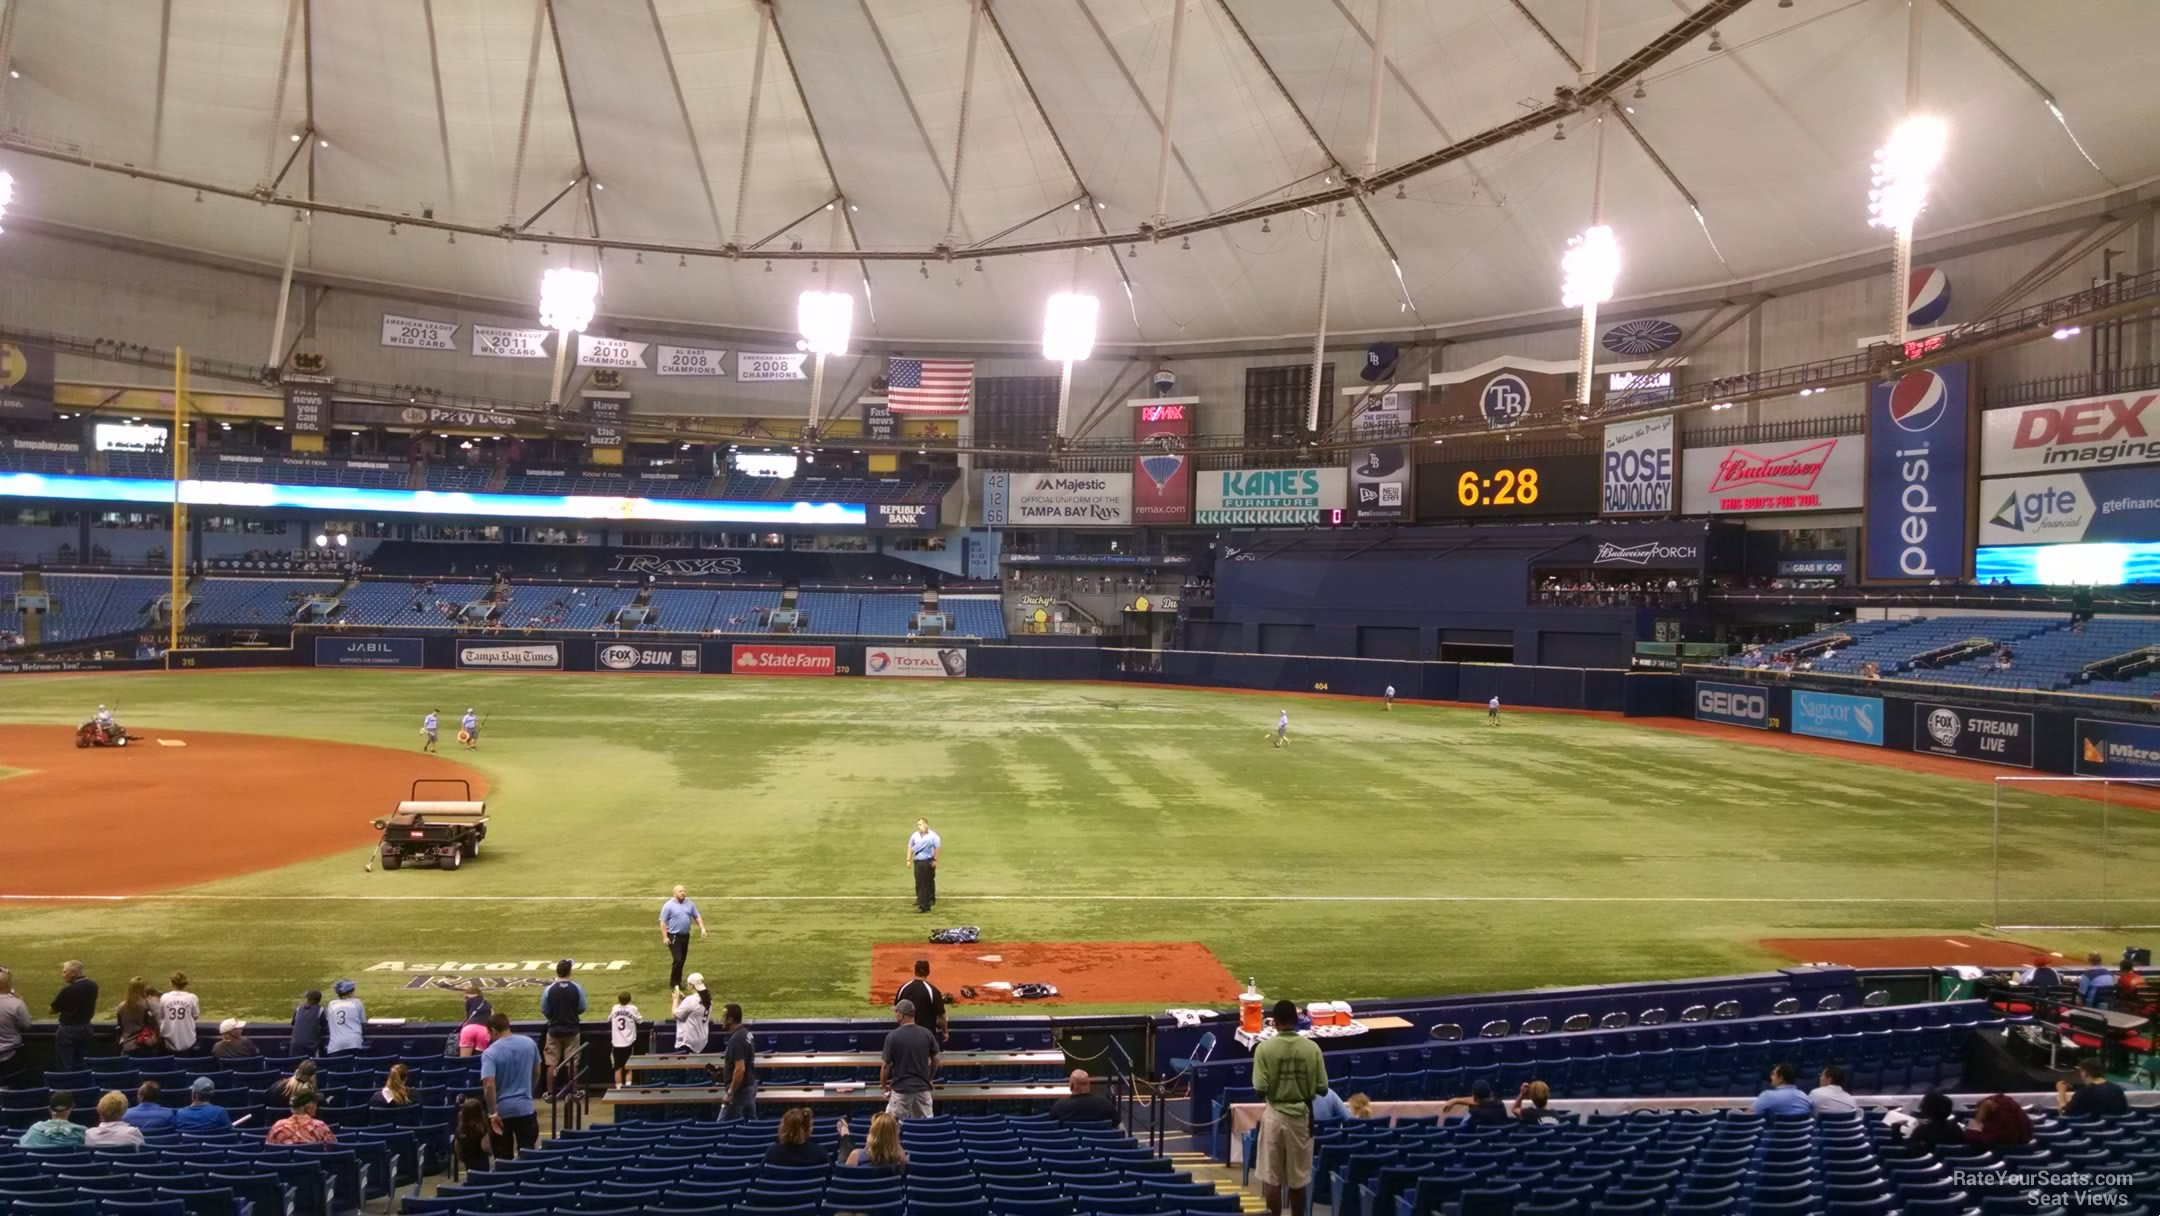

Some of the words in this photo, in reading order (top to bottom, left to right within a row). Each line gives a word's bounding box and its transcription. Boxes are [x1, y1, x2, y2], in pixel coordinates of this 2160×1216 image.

[386, 319, 422, 328] AMERICAN
[424, 323, 452, 332] LEAGUE
[401, 326, 438, 340] 2013
[390, 336, 414, 346] WILD
[416, 338, 446, 348] CARD
[492, 336, 527, 348] 2011
[609, 340, 628, 348] EAST
[480, 346, 505, 354] WILD
[509, 348, 536, 356] CARD
[593, 346, 629, 358] 2010
[582, 356, 638, 366] CHAMPIONS
[672, 355, 708, 366] 2008
[753, 361, 789, 372] 2008
[662, 365, 716, 374] CHAMPIONS
[742, 372, 798, 380] CHAMPIONS
[292, 396, 322, 405] news
[592, 401, 620, 411] Have
[1490, 384, 1522, 419] TB
[297, 406, 318, 415] you
[870, 408, 890, 416] Fast
[297, 414, 318, 422] can
[2012, 395, 2159, 450] DEX
[296, 422, 318, 431] use.
[597, 427, 615, 437] the
[873, 425, 890, 434] you
[14, 439, 78, 452] tampabay.com
[590, 435, 622, 445] buzz?
[2043, 440, 2160, 464] imaging
[283, 458, 303, 466] Know
[1604, 448, 1671, 483] ROSE
[582, 470, 601, 478] Know
[1720, 459, 1823, 482] Budweiser
[988, 476, 1004, 488] 42
[1055, 478, 1106, 493] Majestic
[1222, 470, 1320, 496] KANE'S
[1458, 468, 1538, 506] 6:28
[990, 492, 1002, 505] 12
[1020, 496, 1054, 504] OFFICIAL
[1055, 496, 1091, 504] UNIFORM
[1092, 496, 1104, 504] OF
[1105, 496, 1120, 504] THE
[1225, 498, 1314, 507] FURNITURE
[1382, 494, 1400, 502] ERA
[1604, 482, 1670, 511] RADIOLOGY
[1720, 498, 1742, 510] THIS
[1744, 496, 1774, 509] BUD'S
[1776, 495, 1797, 508] FOR
[879, 505, 926, 515] REPUBLIC
[1136, 504, 1186, 514] remax.com
[2024, 486, 2076, 524] gte
[988, 510, 1003, 522] 66
[1020, 506, 1062, 518] TAMPA
[1064, 506, 1088, 517] BAY
[1896, 449, 1937, 575] pepsi
[888, 514, 917, 524] BANK
[2032, 516, 2082, 533] financial
[1600, 545, 1651, 559] Budweiser
[1652, 546, 1697, 558] PORCH
[1792, 564, 1815, 572] GRAB
[1825, 562, 1842, 572] GO!
[158, 634, 206, 644] LADING
[347, 643, 392, 652] JABIL
[466, 650, 500, 664] Tampa
[501, 650, 522, 664] Bay
[523, 650, 554, 662] Times
[609, 650, 631, 660] FOX
[641, 650, 673, 664] SUN
[895, 656, 938, 666] TOTAL
[1314, 682, 1328, 691] 404
[1698, 690, 1764, 719] GEICO
[1800, 694, 1850, 725] Sagicor
[1934, 714, 1953, 729] FOX
[1968, 718, 2018, 736] STREAM
[1942, 735, 1954, 746] GO
[1980, 736, 2006, 752] LIVE
[2110, 744, 2160, 760] Micro
[364, 960, 633, 972] AstroTurf
[168, 1007, 186, 1021] 39
[336, 1010, 346, 1026] 3
[618, 1018, 626, 1031] 3
